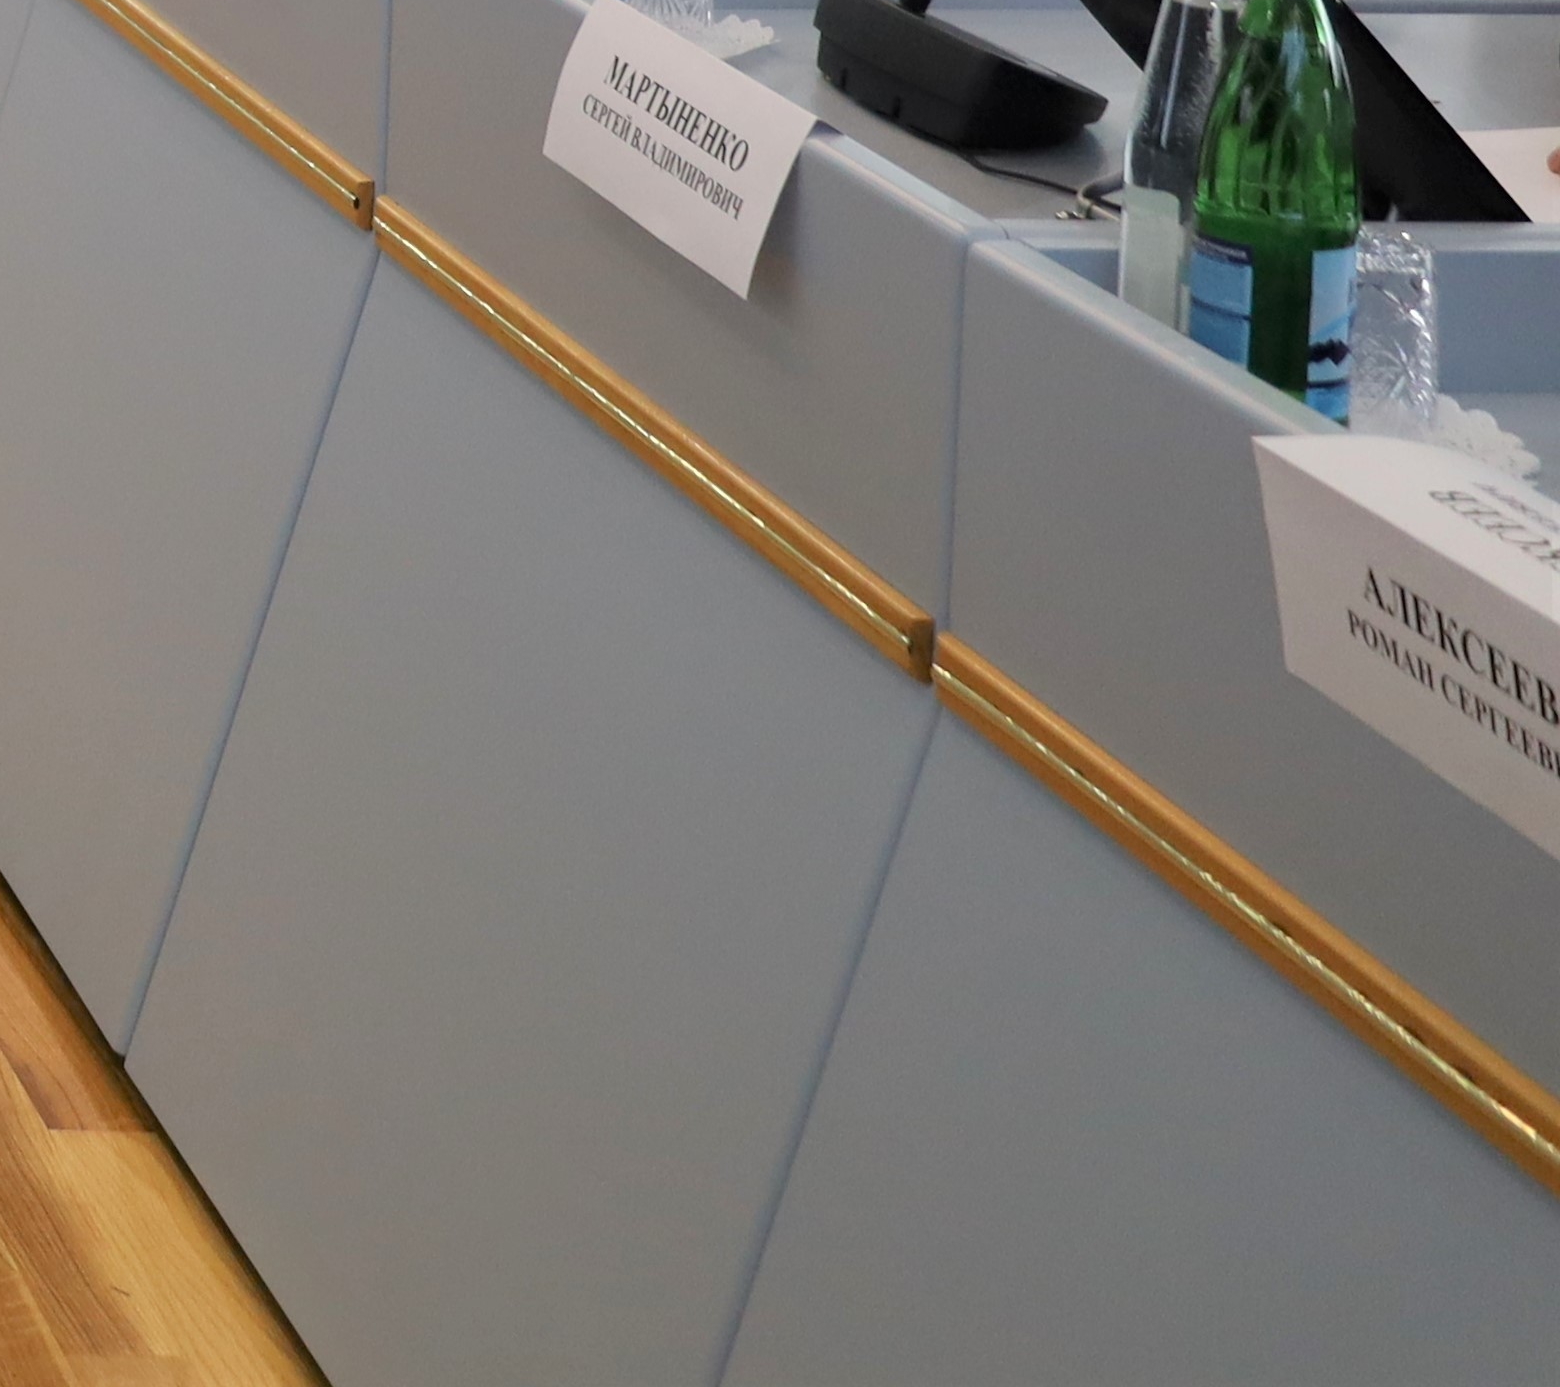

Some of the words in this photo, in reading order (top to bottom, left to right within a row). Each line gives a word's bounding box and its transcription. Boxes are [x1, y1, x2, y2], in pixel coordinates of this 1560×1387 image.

[582, 93, 633, 143] СЕРГЕЙ
[630, 126, 744, 220] ВЛАДИМИРОВИЧ
[604, 55, 750, 172] МАРТЫНЕНКО
[1347, 608, 1435, 692] РОМАН
[1365, 567, 1560, 726] АЛЕКСЕЕВ
